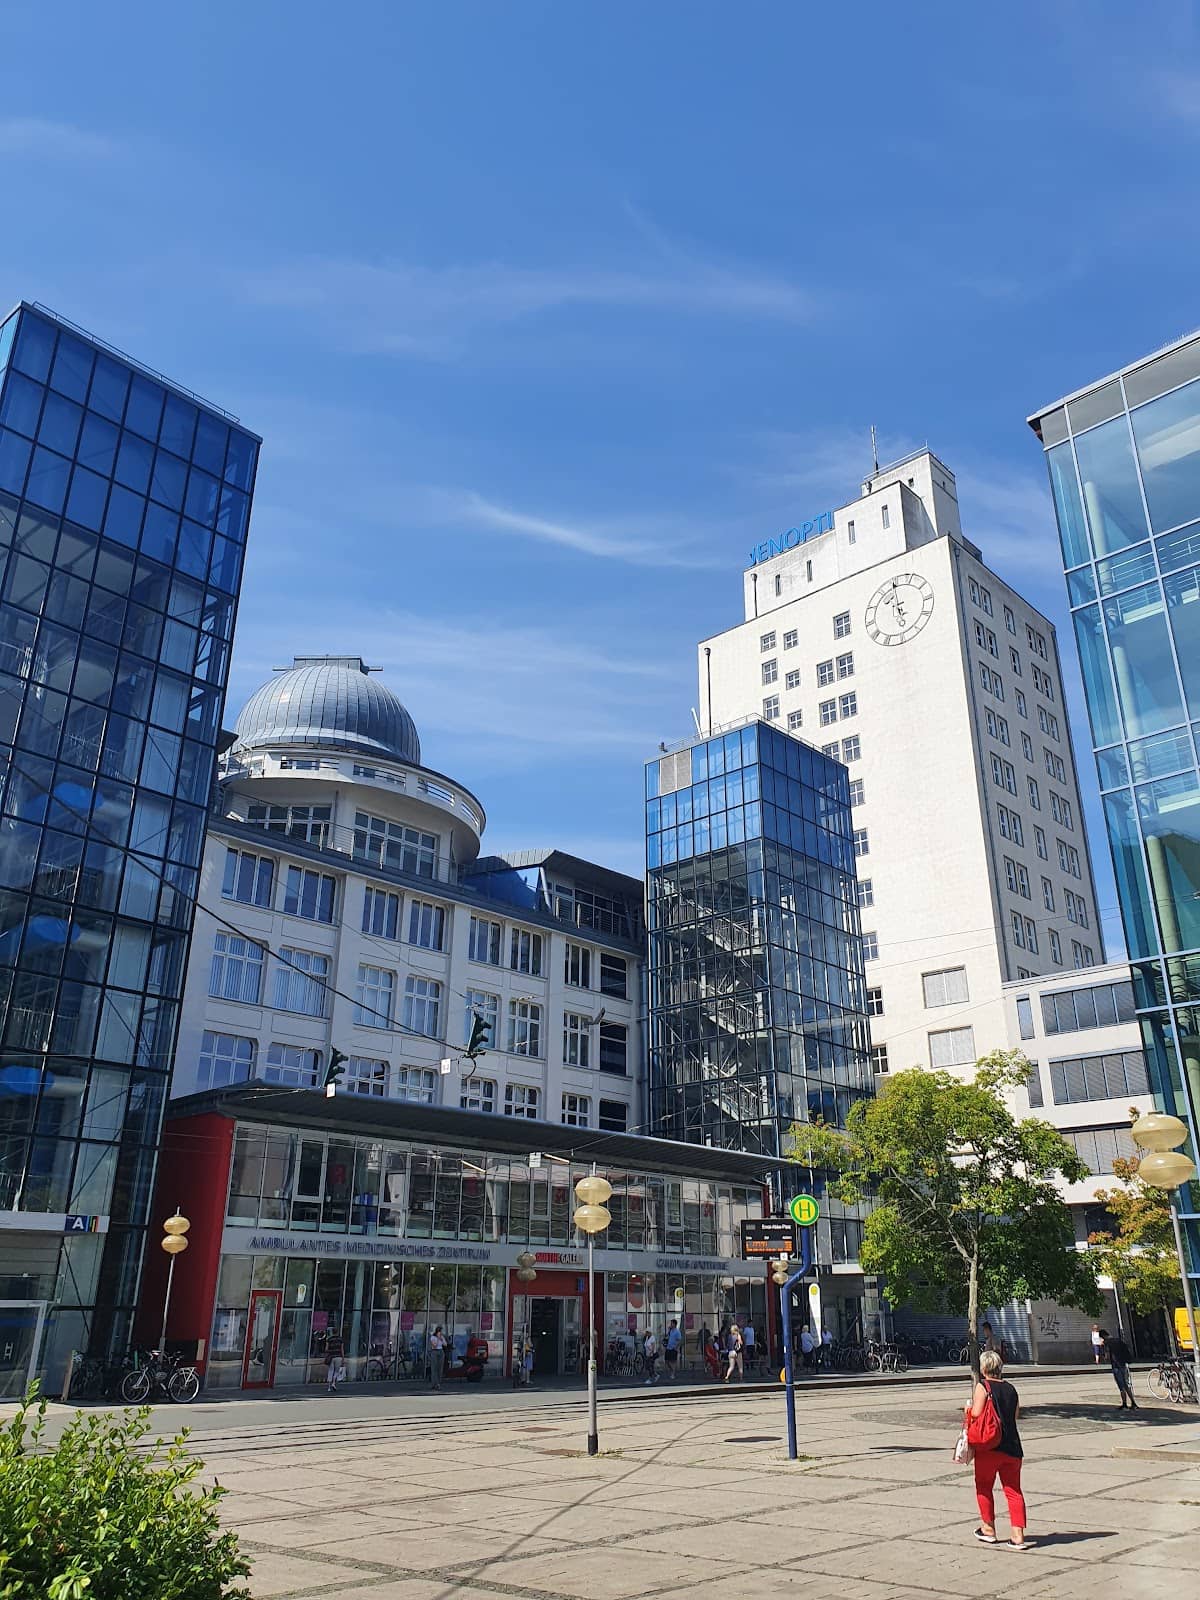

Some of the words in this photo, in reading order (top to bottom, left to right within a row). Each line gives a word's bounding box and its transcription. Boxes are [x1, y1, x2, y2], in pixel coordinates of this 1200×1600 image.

[749, 511, 833, 566] JENOPTI
[799, 1202, 811, 1218] H
[72, 1217, 84, 1230] A
[249, 1235, 342, 1253] AMBULANTES
[560, 1253, 584, 1265] GALE
